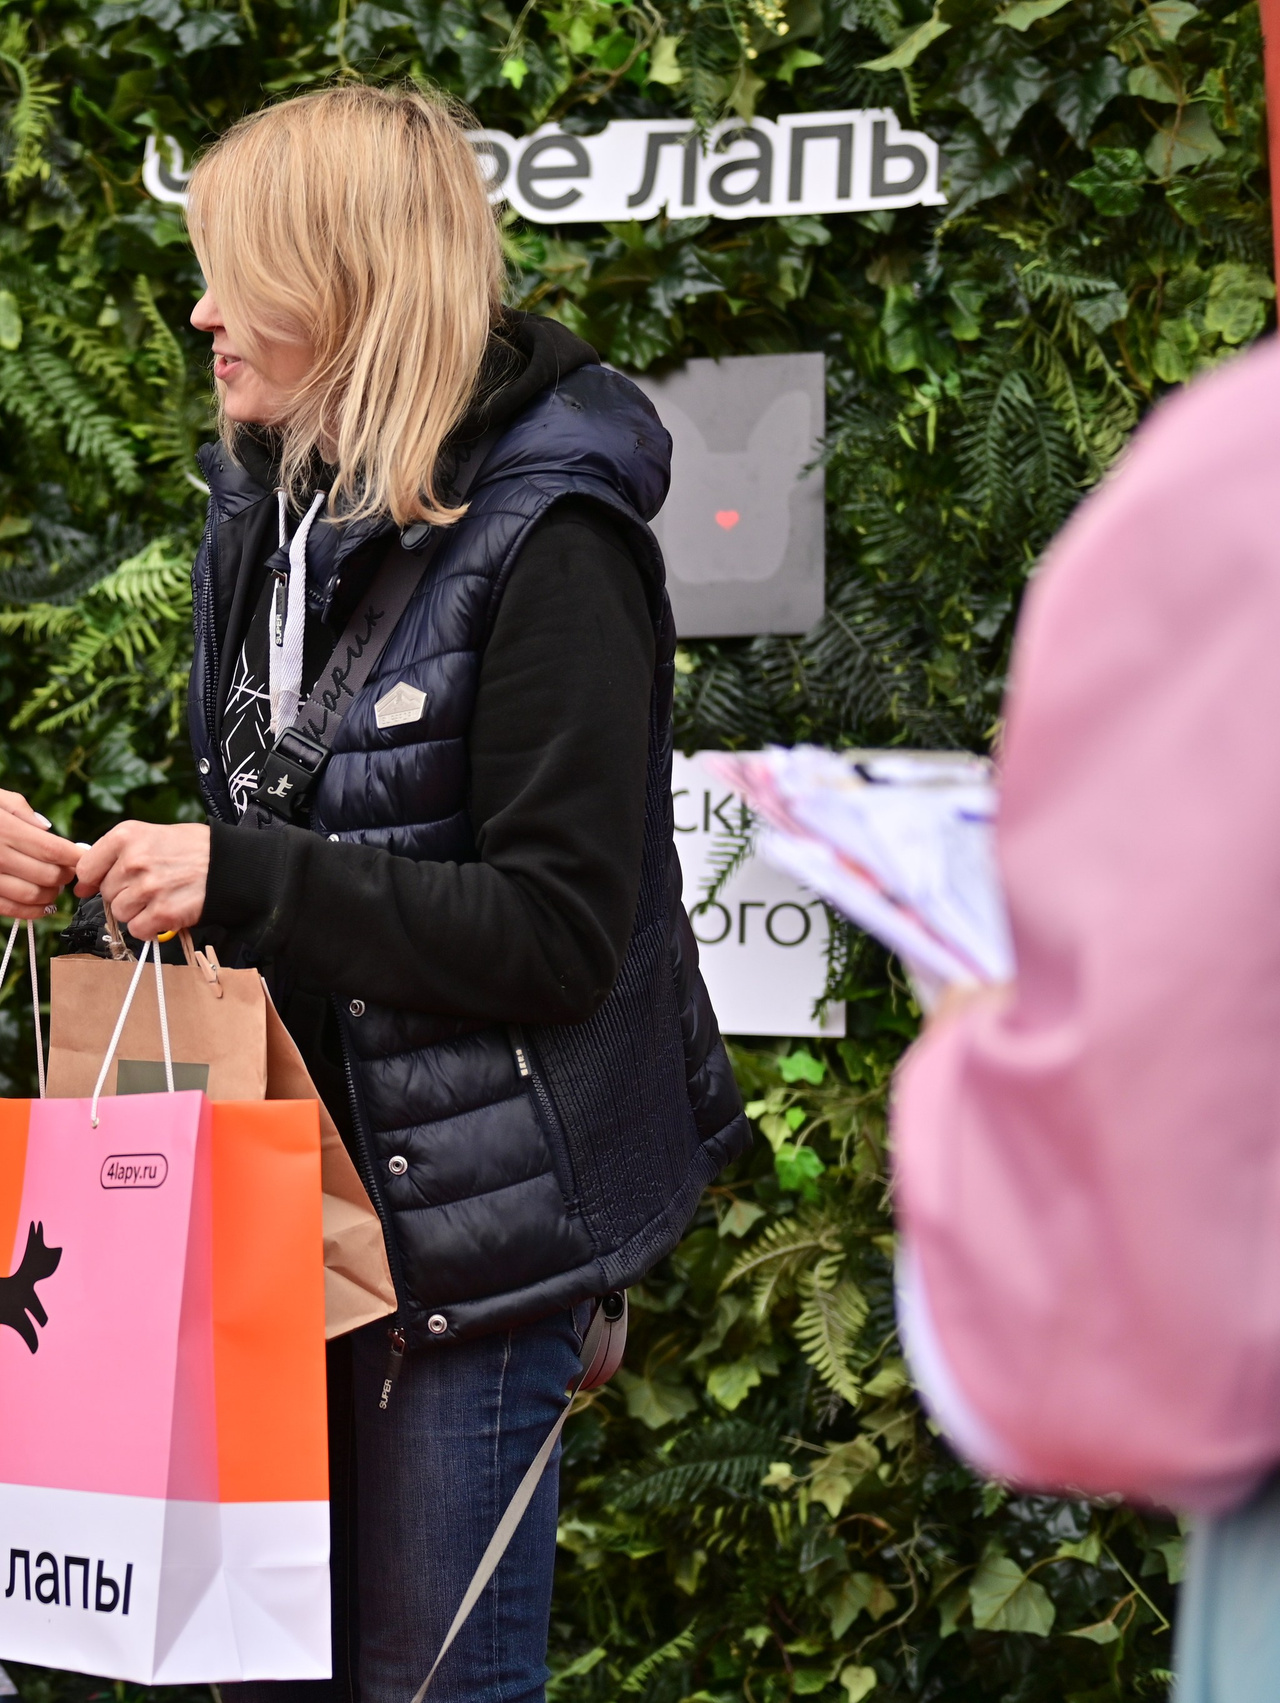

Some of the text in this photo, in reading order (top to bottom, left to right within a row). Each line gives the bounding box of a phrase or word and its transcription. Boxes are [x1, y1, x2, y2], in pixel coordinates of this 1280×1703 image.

[107, 1162, 158, 1184] 4lapy.ru
[379, 1378, 392, 1410] SUPER
[5, 1546, 135, 1616] лапы
